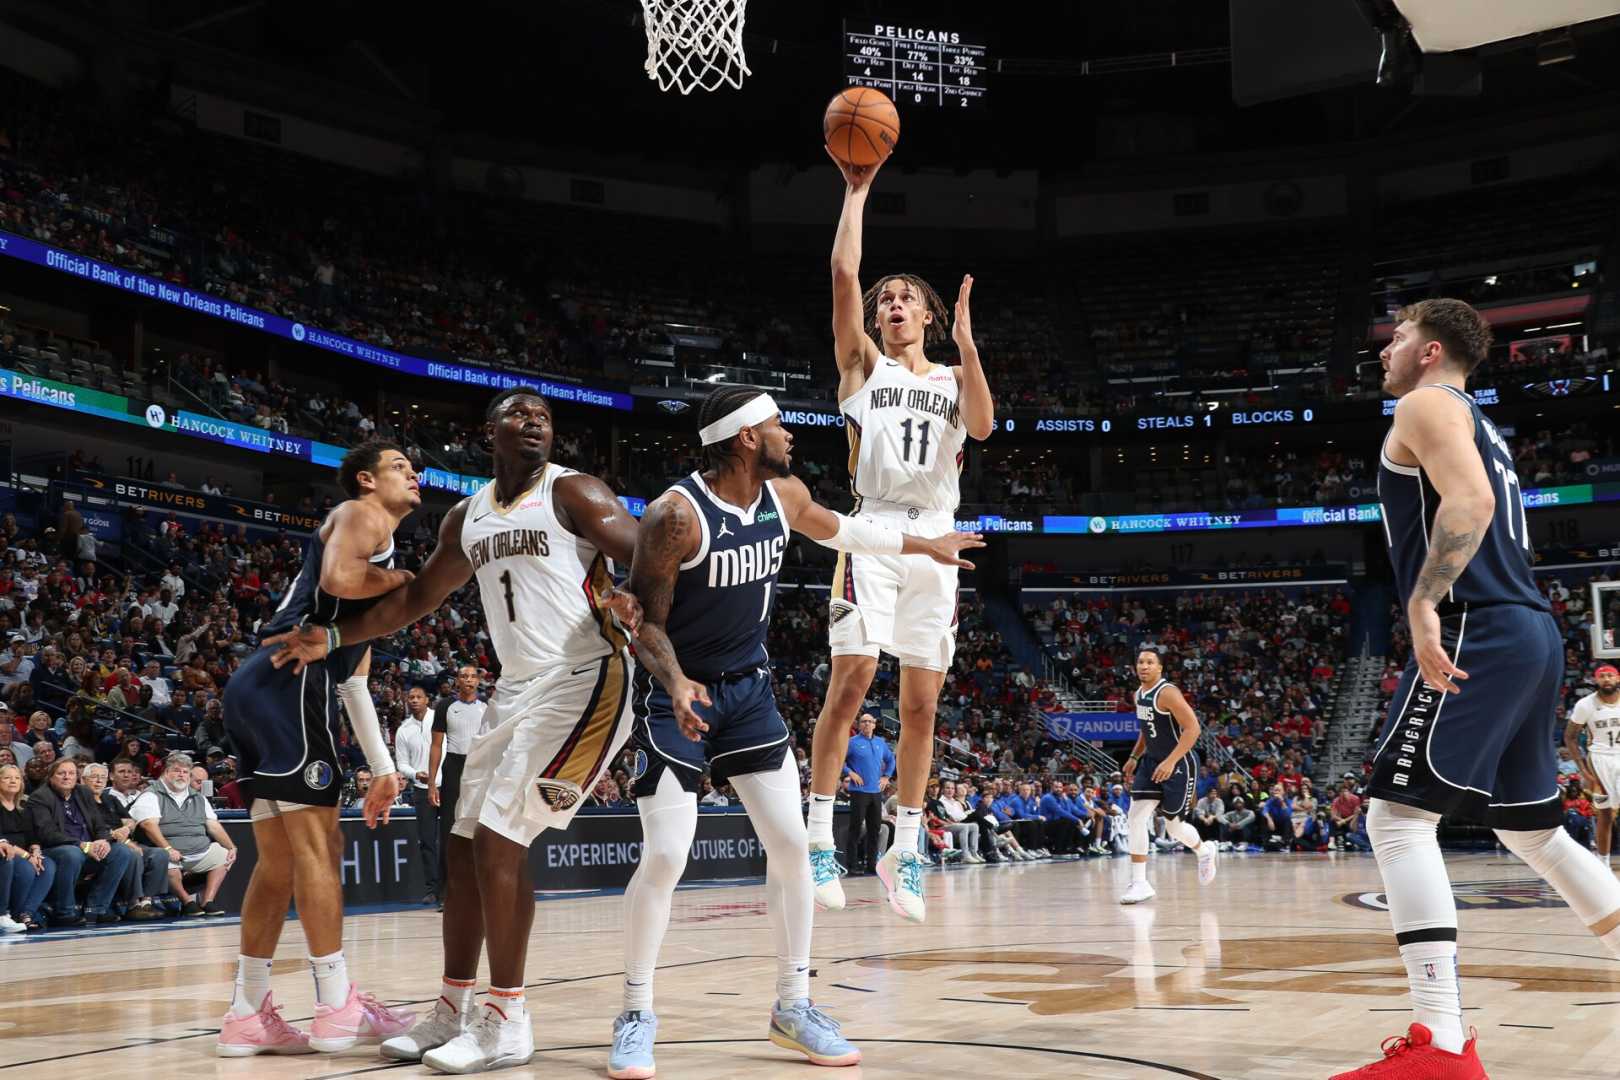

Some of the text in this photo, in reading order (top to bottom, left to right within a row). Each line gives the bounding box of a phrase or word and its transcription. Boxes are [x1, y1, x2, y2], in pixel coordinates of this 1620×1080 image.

[875, 25, 960, 44] PELICANS
[860, 46, 881, 57] 40%
[907, 51, 928, 61] 77%
[954, 56, 974, 66] 33%
[864, 67, 871, 76] 4
[912, 72, 924, 81] 14
[958, 77, 970, 86] 18
[914, 94, 921, 102] 0
[961, 98, 968, 107] 2
[47, 250, 264, 328] Official Bank of the New Orleans Pelicans
[308, 331, 401, 367] HANCOCK WHITNEY
[12, 375, 75, 407] Pelicans
[428, 363, 462, 380] Official
[465, 370, 489, 386] Bank
[491, 375, 501, 387] of
[502, 375, 517, 390] the
[540, 383, 574, 400] Orleans
[576, 388, 613, 406] Pelicans
[1474, 388, 1496, 398] TEAM
[870, 387, 960, 429] NEW ORLEANS
[1138, 415, 1212, 430] STEALS 1
[1232, 409, 1313, 425] BLOCKS 0
[1006, 420, 1014, 432] 0
[1036, 420, 1094, 431] ASSISTS
[1102, 420, 1110, 432] 0
[170, 415, 301, 455] HANCOCK WHITNEY
[900, 418, 930, 465] 11
[430, 472, 444, 488] the
[447, 473, 468, 495] New
[115, 482, 206, 510] BETRIVERS
[1493, 457, 1528, 550] 77
[1523, 492, 1559, 505] icans
[254, 508, 321, 528] BETRIVER
[758, 511, 778, 522] chime
[1303, 506, 1379, 522] Official Bank
[956, 518, 1033, 532] eans Pelicans
[1111, 515, 1240, 530] HANCOCK WHITNEY
[469, 529, 550, 570] NEW ORLEANS
[1090, 574, 1168, 585] BETRIVERS
[1218, 568, 1302, 580] BETRIVERS
[500, 569, 515, 622] 1
[760, 581, 772, 622] 1
[1076, 721, 1140, 732] FANDUEL
[1147, 722, 1157, 738] 3
[1393, 682, 1433, 785] MAVERIC
[1607, 731, 1620, 747] 14
[691, 839, 735, 860] UTURE
[738, 838, 756, 858] OF
[340, 839, 407, 884] HIF
